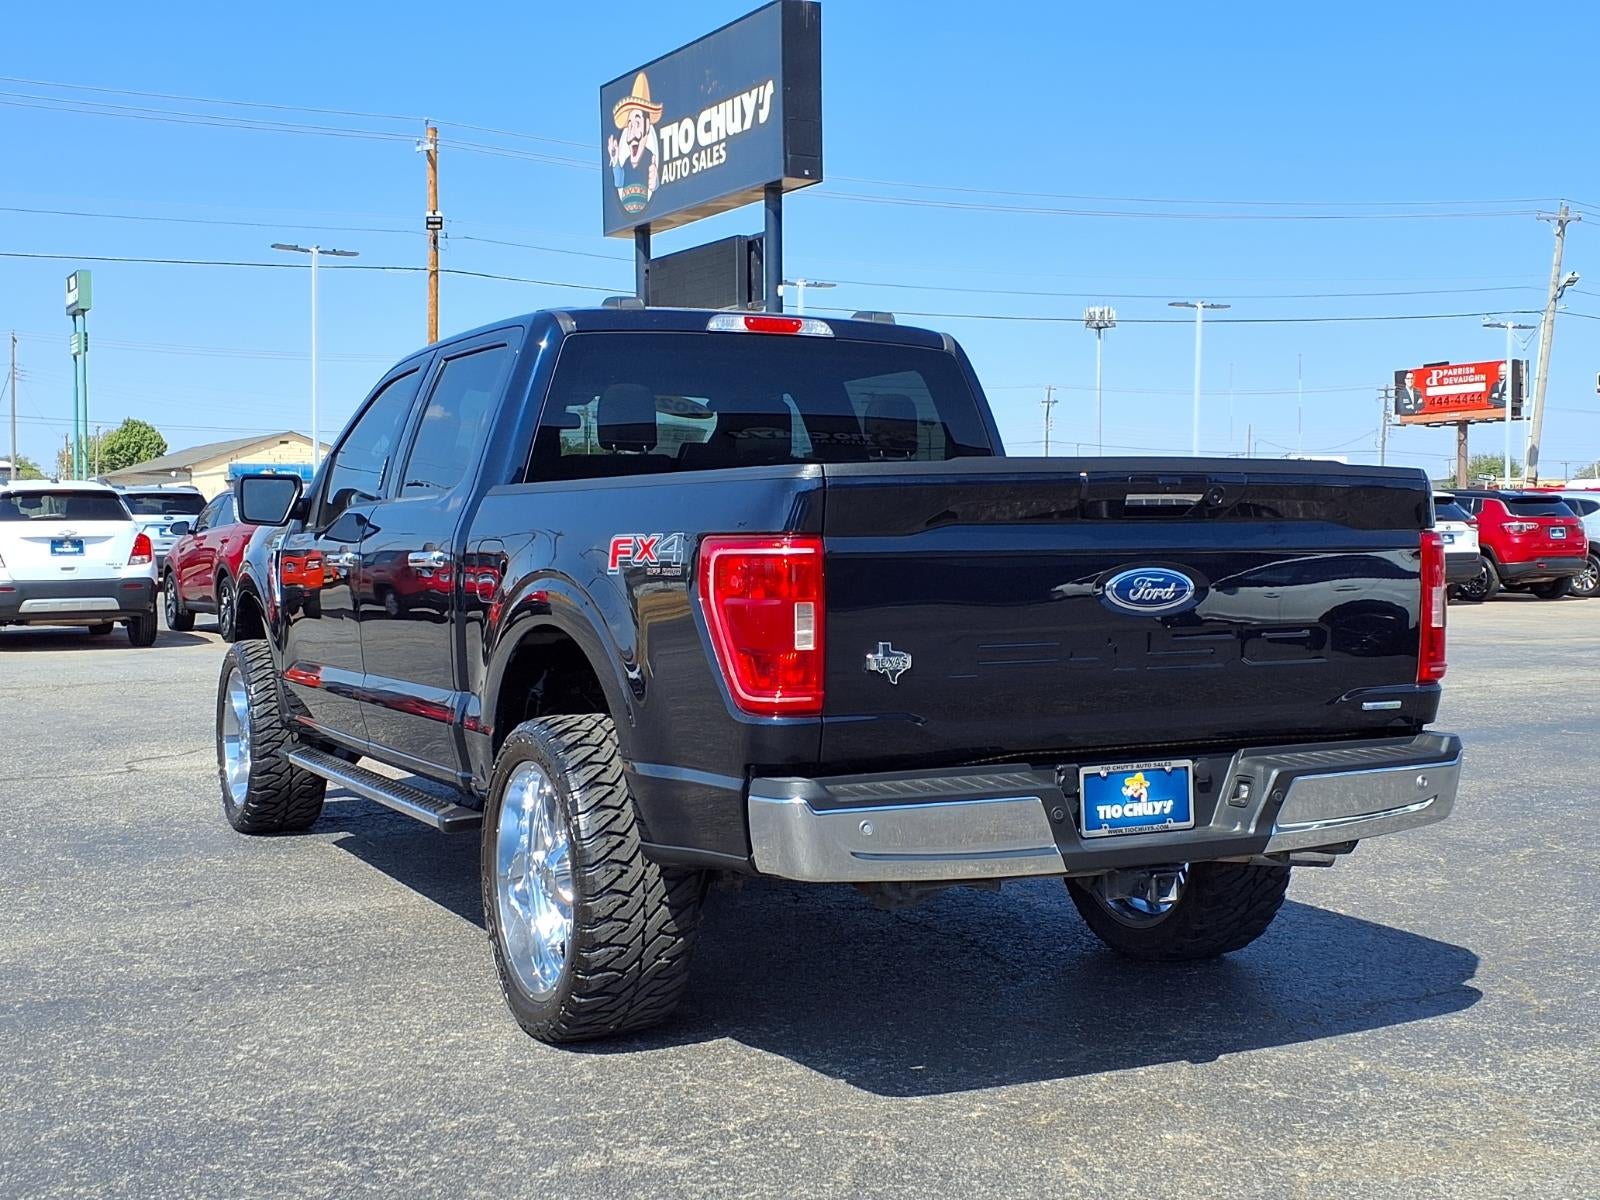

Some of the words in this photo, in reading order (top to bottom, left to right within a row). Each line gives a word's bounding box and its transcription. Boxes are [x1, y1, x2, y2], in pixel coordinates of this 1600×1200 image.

[660, 117, 695, 160] TIO
[697, 80, 774, 147] CHUY'S
[661, 157, 690, 185] AUTO
[692, 142, 727, 174] SALES
[1443, 367, 1475, 376] PARRISH
[1443, 374, 1486, 385] DEVAUGHN
[1429, 393, 1482, 406] 444-4444
[607, 532, 684, 575] FX4
[1129, 576, 1176, 601] Ford
[875, 656, 908, 670] TEXAS
[1097, 804, 1122, 819] TIO
[1122, 799, 1173, 817] CHUY'S
